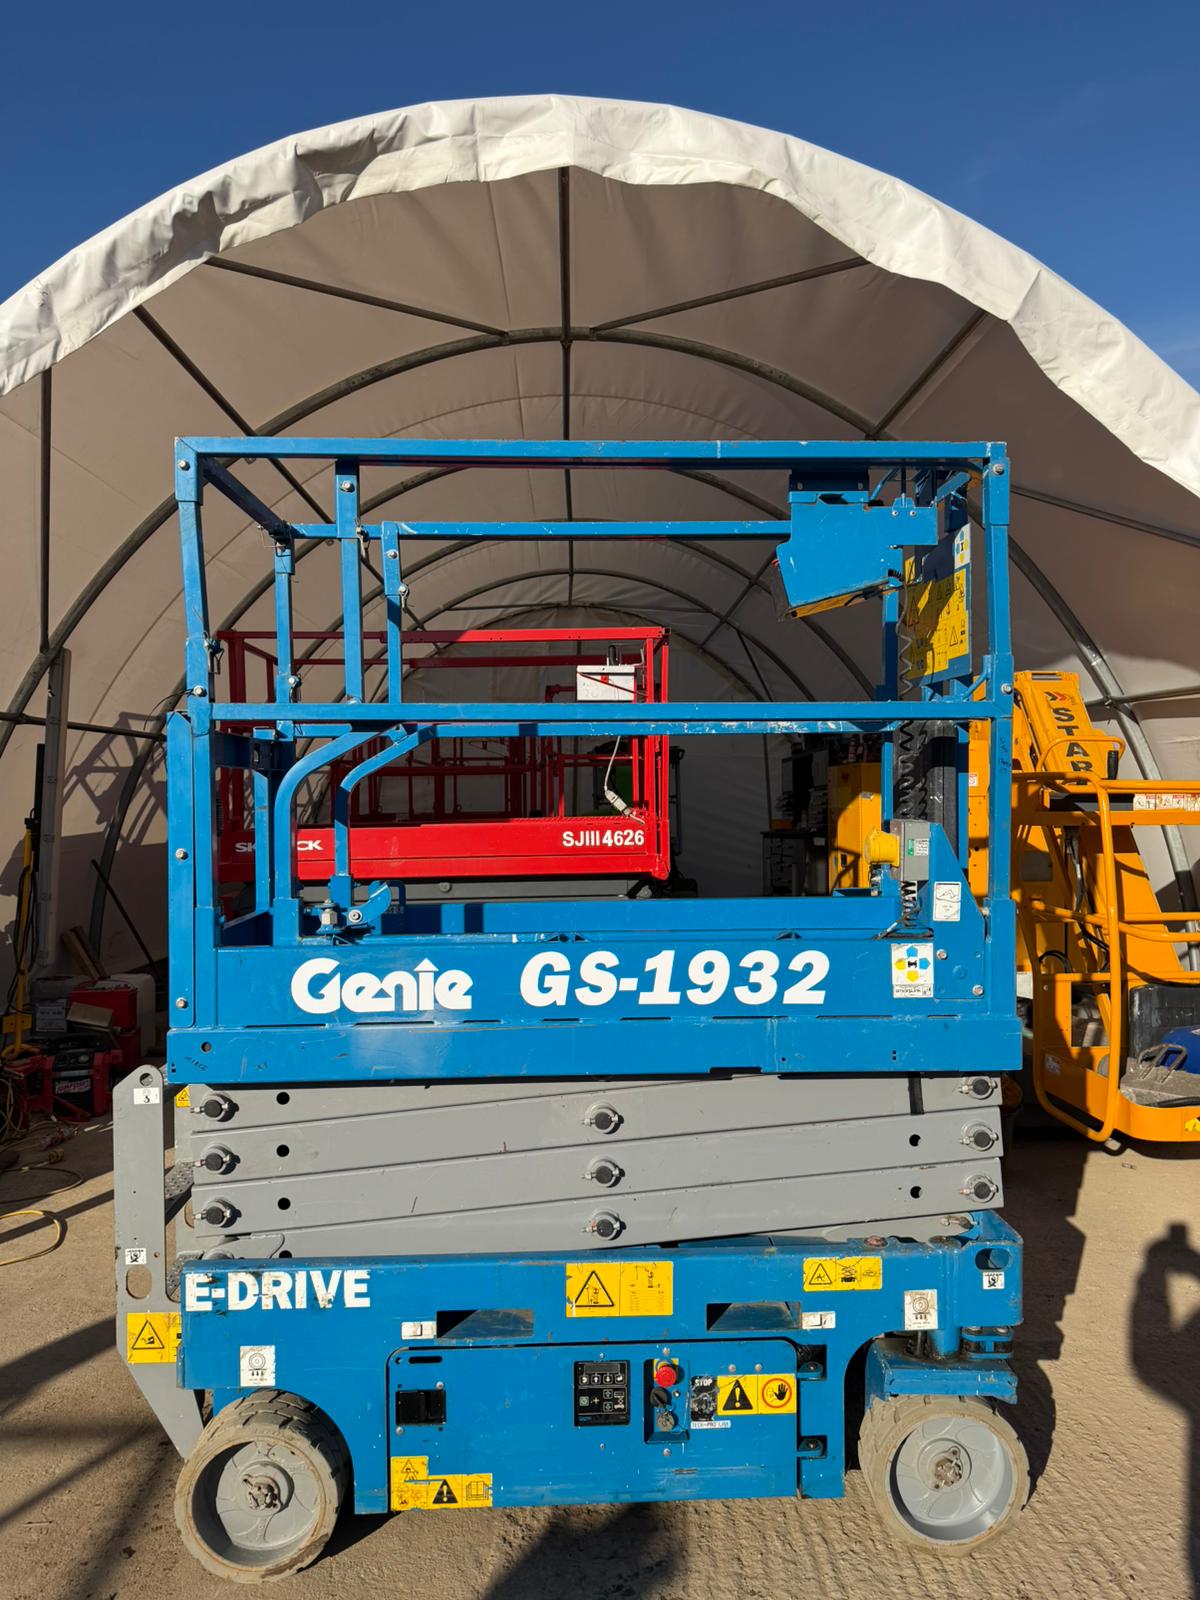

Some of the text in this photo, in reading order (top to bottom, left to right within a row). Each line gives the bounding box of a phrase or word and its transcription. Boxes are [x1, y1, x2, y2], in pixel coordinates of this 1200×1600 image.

[290, 957, 474, 1014] Genie
[519, 950, 830, 1007] GS-1932
[185, 1269, 371, 1311] E-DRIVE
[694, 1378, 713, 1387] STOP
